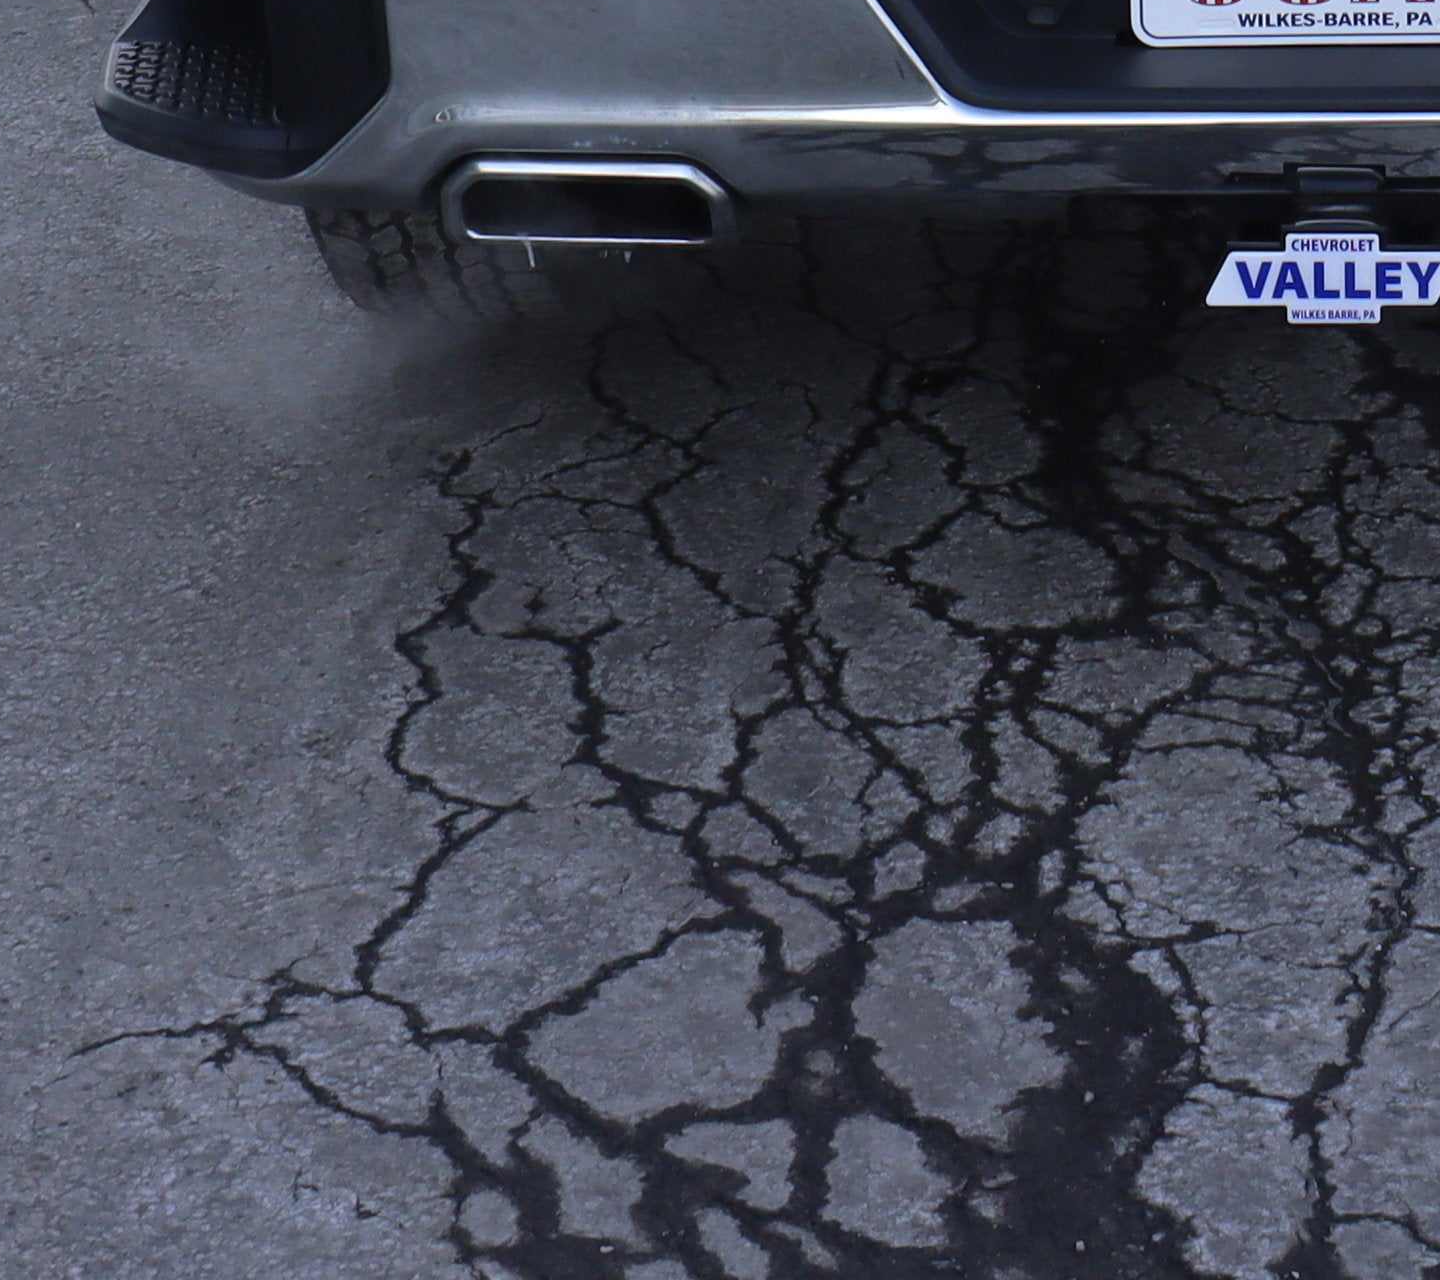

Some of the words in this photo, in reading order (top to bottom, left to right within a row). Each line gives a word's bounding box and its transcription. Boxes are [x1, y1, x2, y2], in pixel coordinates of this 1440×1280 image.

[1237, 12, 1400, 29] WILKES-BARRE,
[1406, 12, 1433, 28] PA
[1291, 239, 1375, 252] CHEVROLET
[1291, 309, 1326, 320] WILKES
[1328, 309, 1361, 321] BARRE,
[1363, 309, 1376, 320] PA
